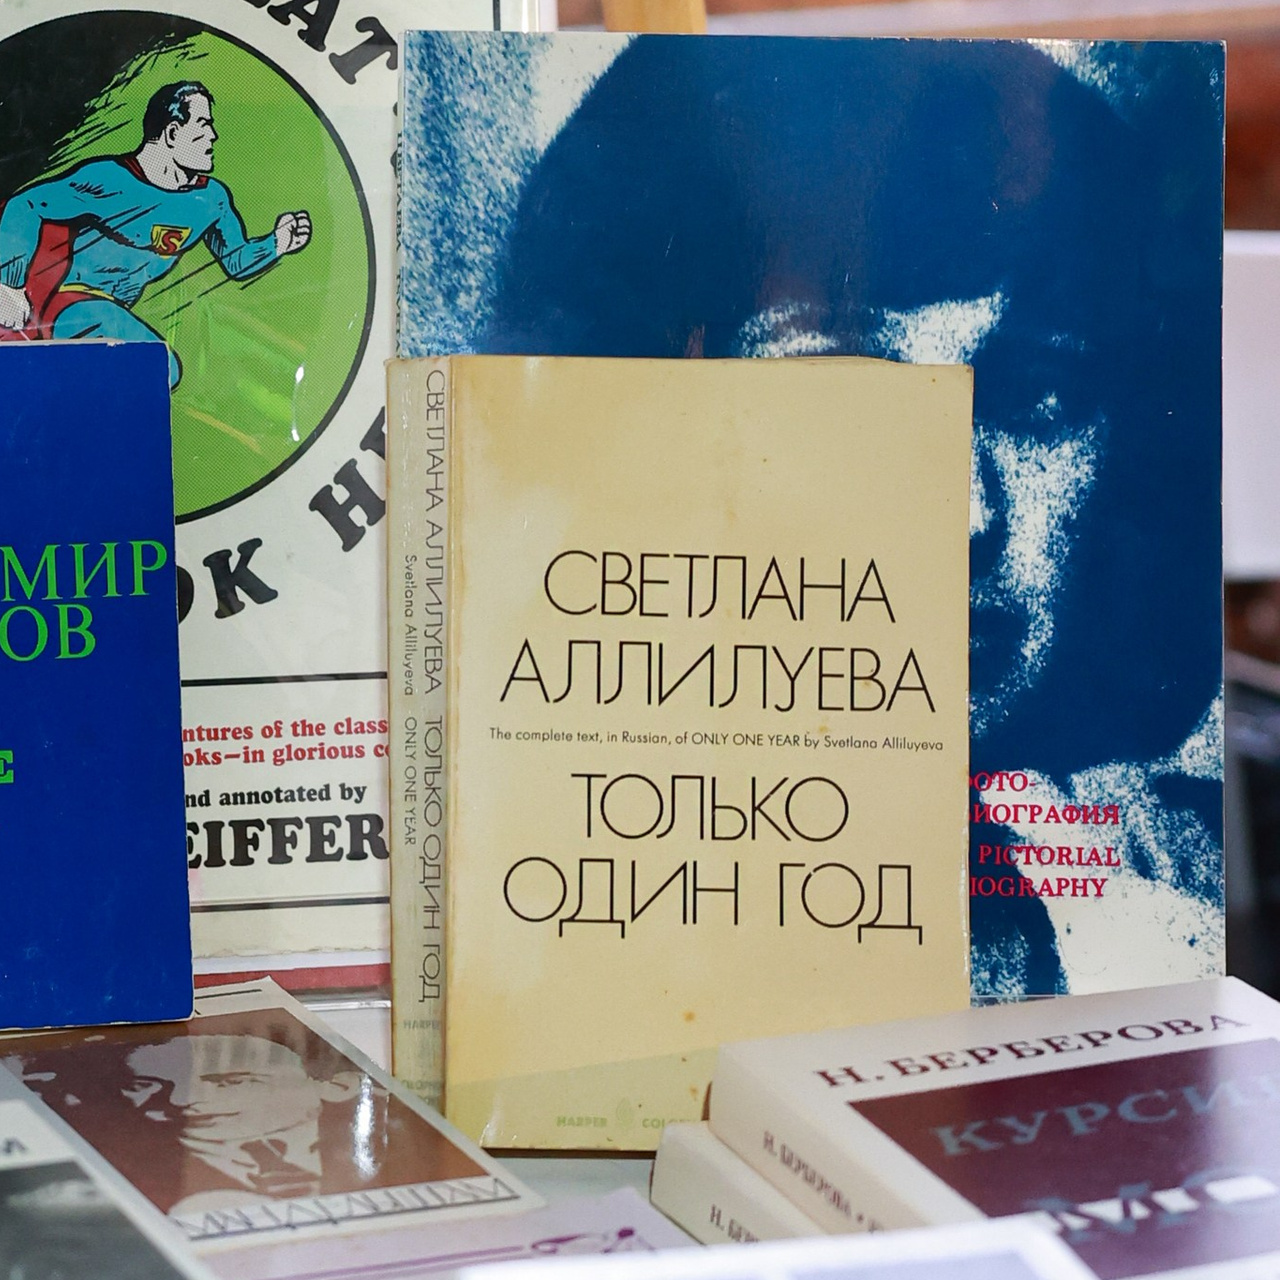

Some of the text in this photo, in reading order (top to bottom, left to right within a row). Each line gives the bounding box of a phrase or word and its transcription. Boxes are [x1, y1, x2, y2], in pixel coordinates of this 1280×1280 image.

[403, 555, 418, 617] Svetlana
[543, 549, 896, 623] СВЕТЛАНА
[418, 368, 445, 1004] СВЕТЛАНА АЛЛИЛУЕВА ТОЛЬКО ОДИН ГОД
[499, 637, 936, 713] АЛЛИЛУЕВА
[261, 720, 283, 738] of
[290, 719, 326, 737] the
[333, 717, 388, 735] class
[404, 715, 419, 760] ONLY
[489, 727, 944, 754] The complete text, in Russian, of ONLY ONE YEAR by Svetlana Alliluyeva
[272, 742, 365, 766] glorious
[219, 784, 331, 806] annotated
[338, 783, 367, 803] by
[404, 766, 418, 803] ONE
[969, 771, 1036, 792] ОТО-
[403, 805, 417, 846] YEAR
[570, 773, 849, 842] ТОЛЬКО
[969, 803, 1121, 826] ИОГРАФИЯ
[977, 843, 1122, 868] PICTORIAL
[503, 855, 923, 946] ОДИН ГОД
[812, 1014, 1252, 1090] Н. БЕРБЕРОВА
